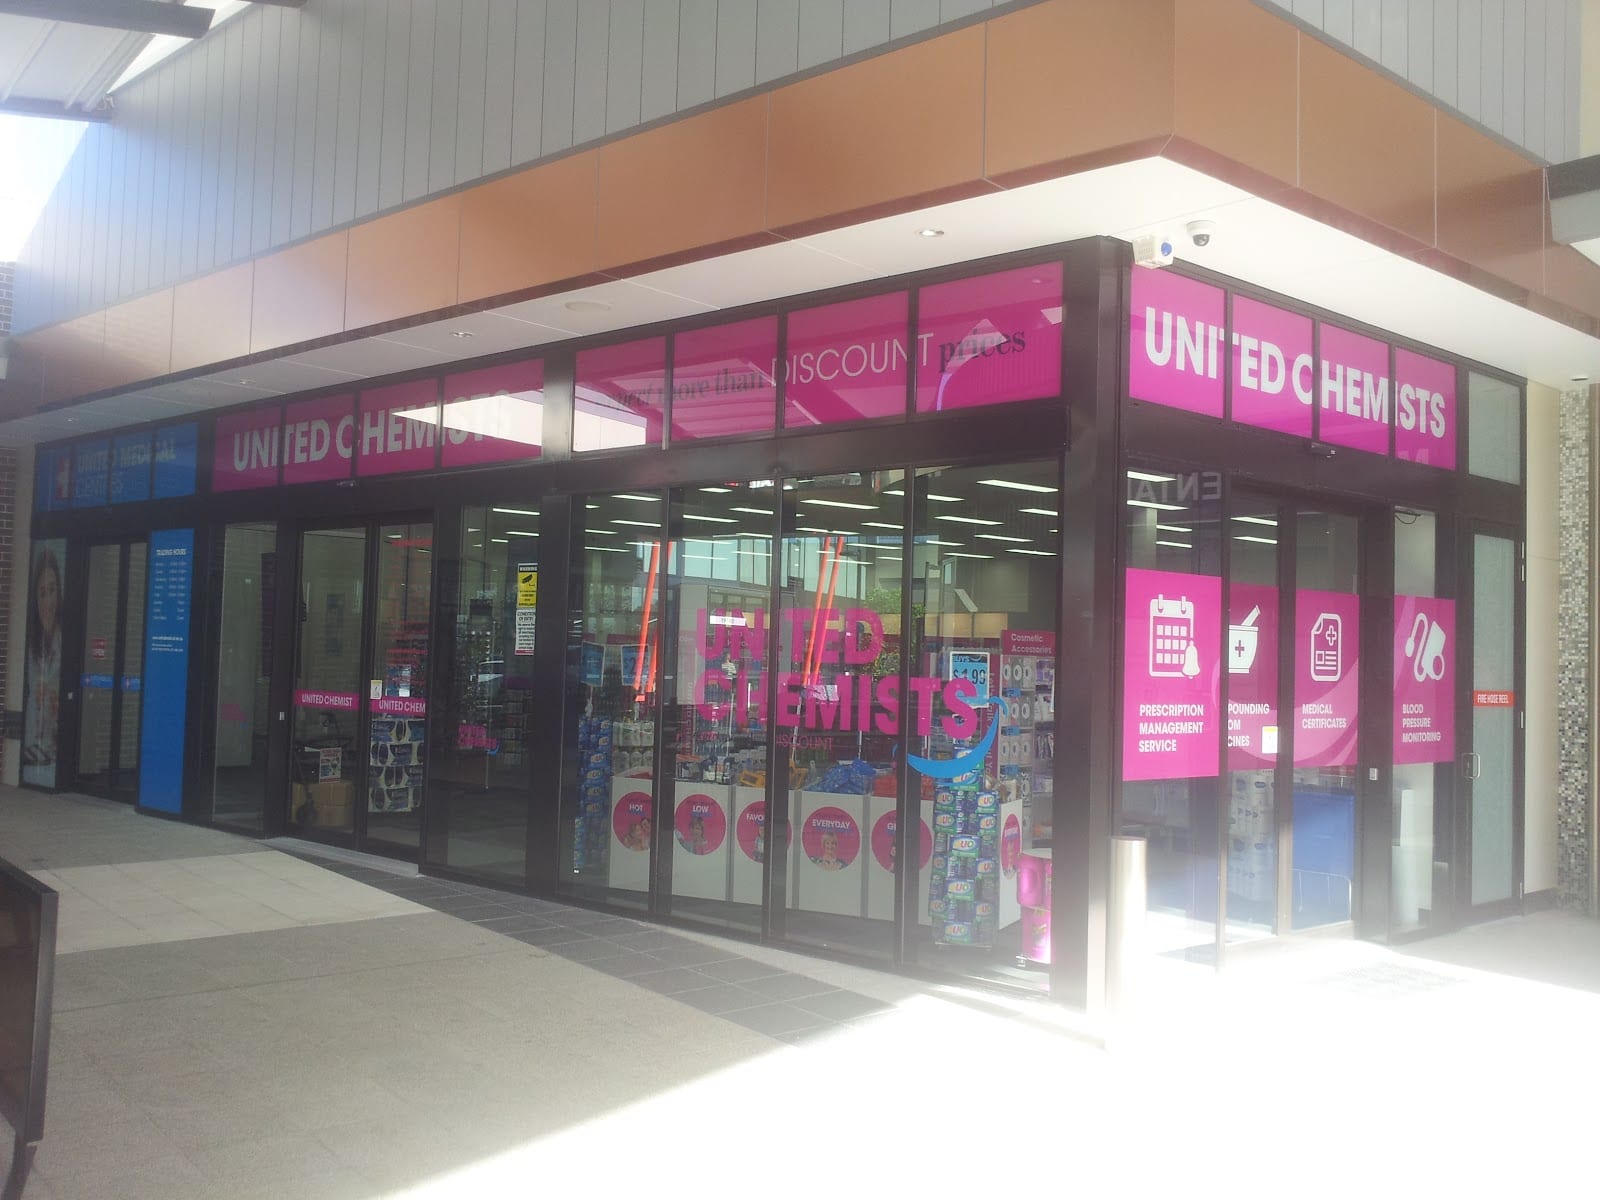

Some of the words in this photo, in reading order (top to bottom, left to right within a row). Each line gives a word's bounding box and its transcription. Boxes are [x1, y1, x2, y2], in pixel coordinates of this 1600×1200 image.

[713, 368, 764, 395] than
[771, 332, 934, 388] DISCOUNT
[939, 327, 1026, 373] prices
[233, 418, 330, 471] UNITED
[336, 389, 511, 459] CHEMSTS
[121, 438, 177, 467] MEDIAL
[697, 608, 884, 664] UNTED
[1011, 633, 1044, 642] Cosmetic
[302, 694, 323, 704] UNITED
[324, 695, 353, 707] CHEMIST
[379, 700, 404, 711] UNITED
[404, 701, 426, 712] CHEM
[695, 669, 978, 739] CHEMISTS
[1139, 703, 1204, 717] PRESCRIPTION
[1302, 703, 1333, 714] MEDICAL
[1402, 703, 1424, 714] BLOOD
[1139, 722, 1204, 735] MANAGEMENT
[1302, 717, 1347, 729] CERTIFICATES
[1402, 717, 1431, 728] PRESSURE
[1402, 731, 1441, 743] MONITORING
[1138, 739, 1177, 752] SERVICE
[692, 805, 709, 813] LOW
[812, 819, 851, 830] EVERYDAY
